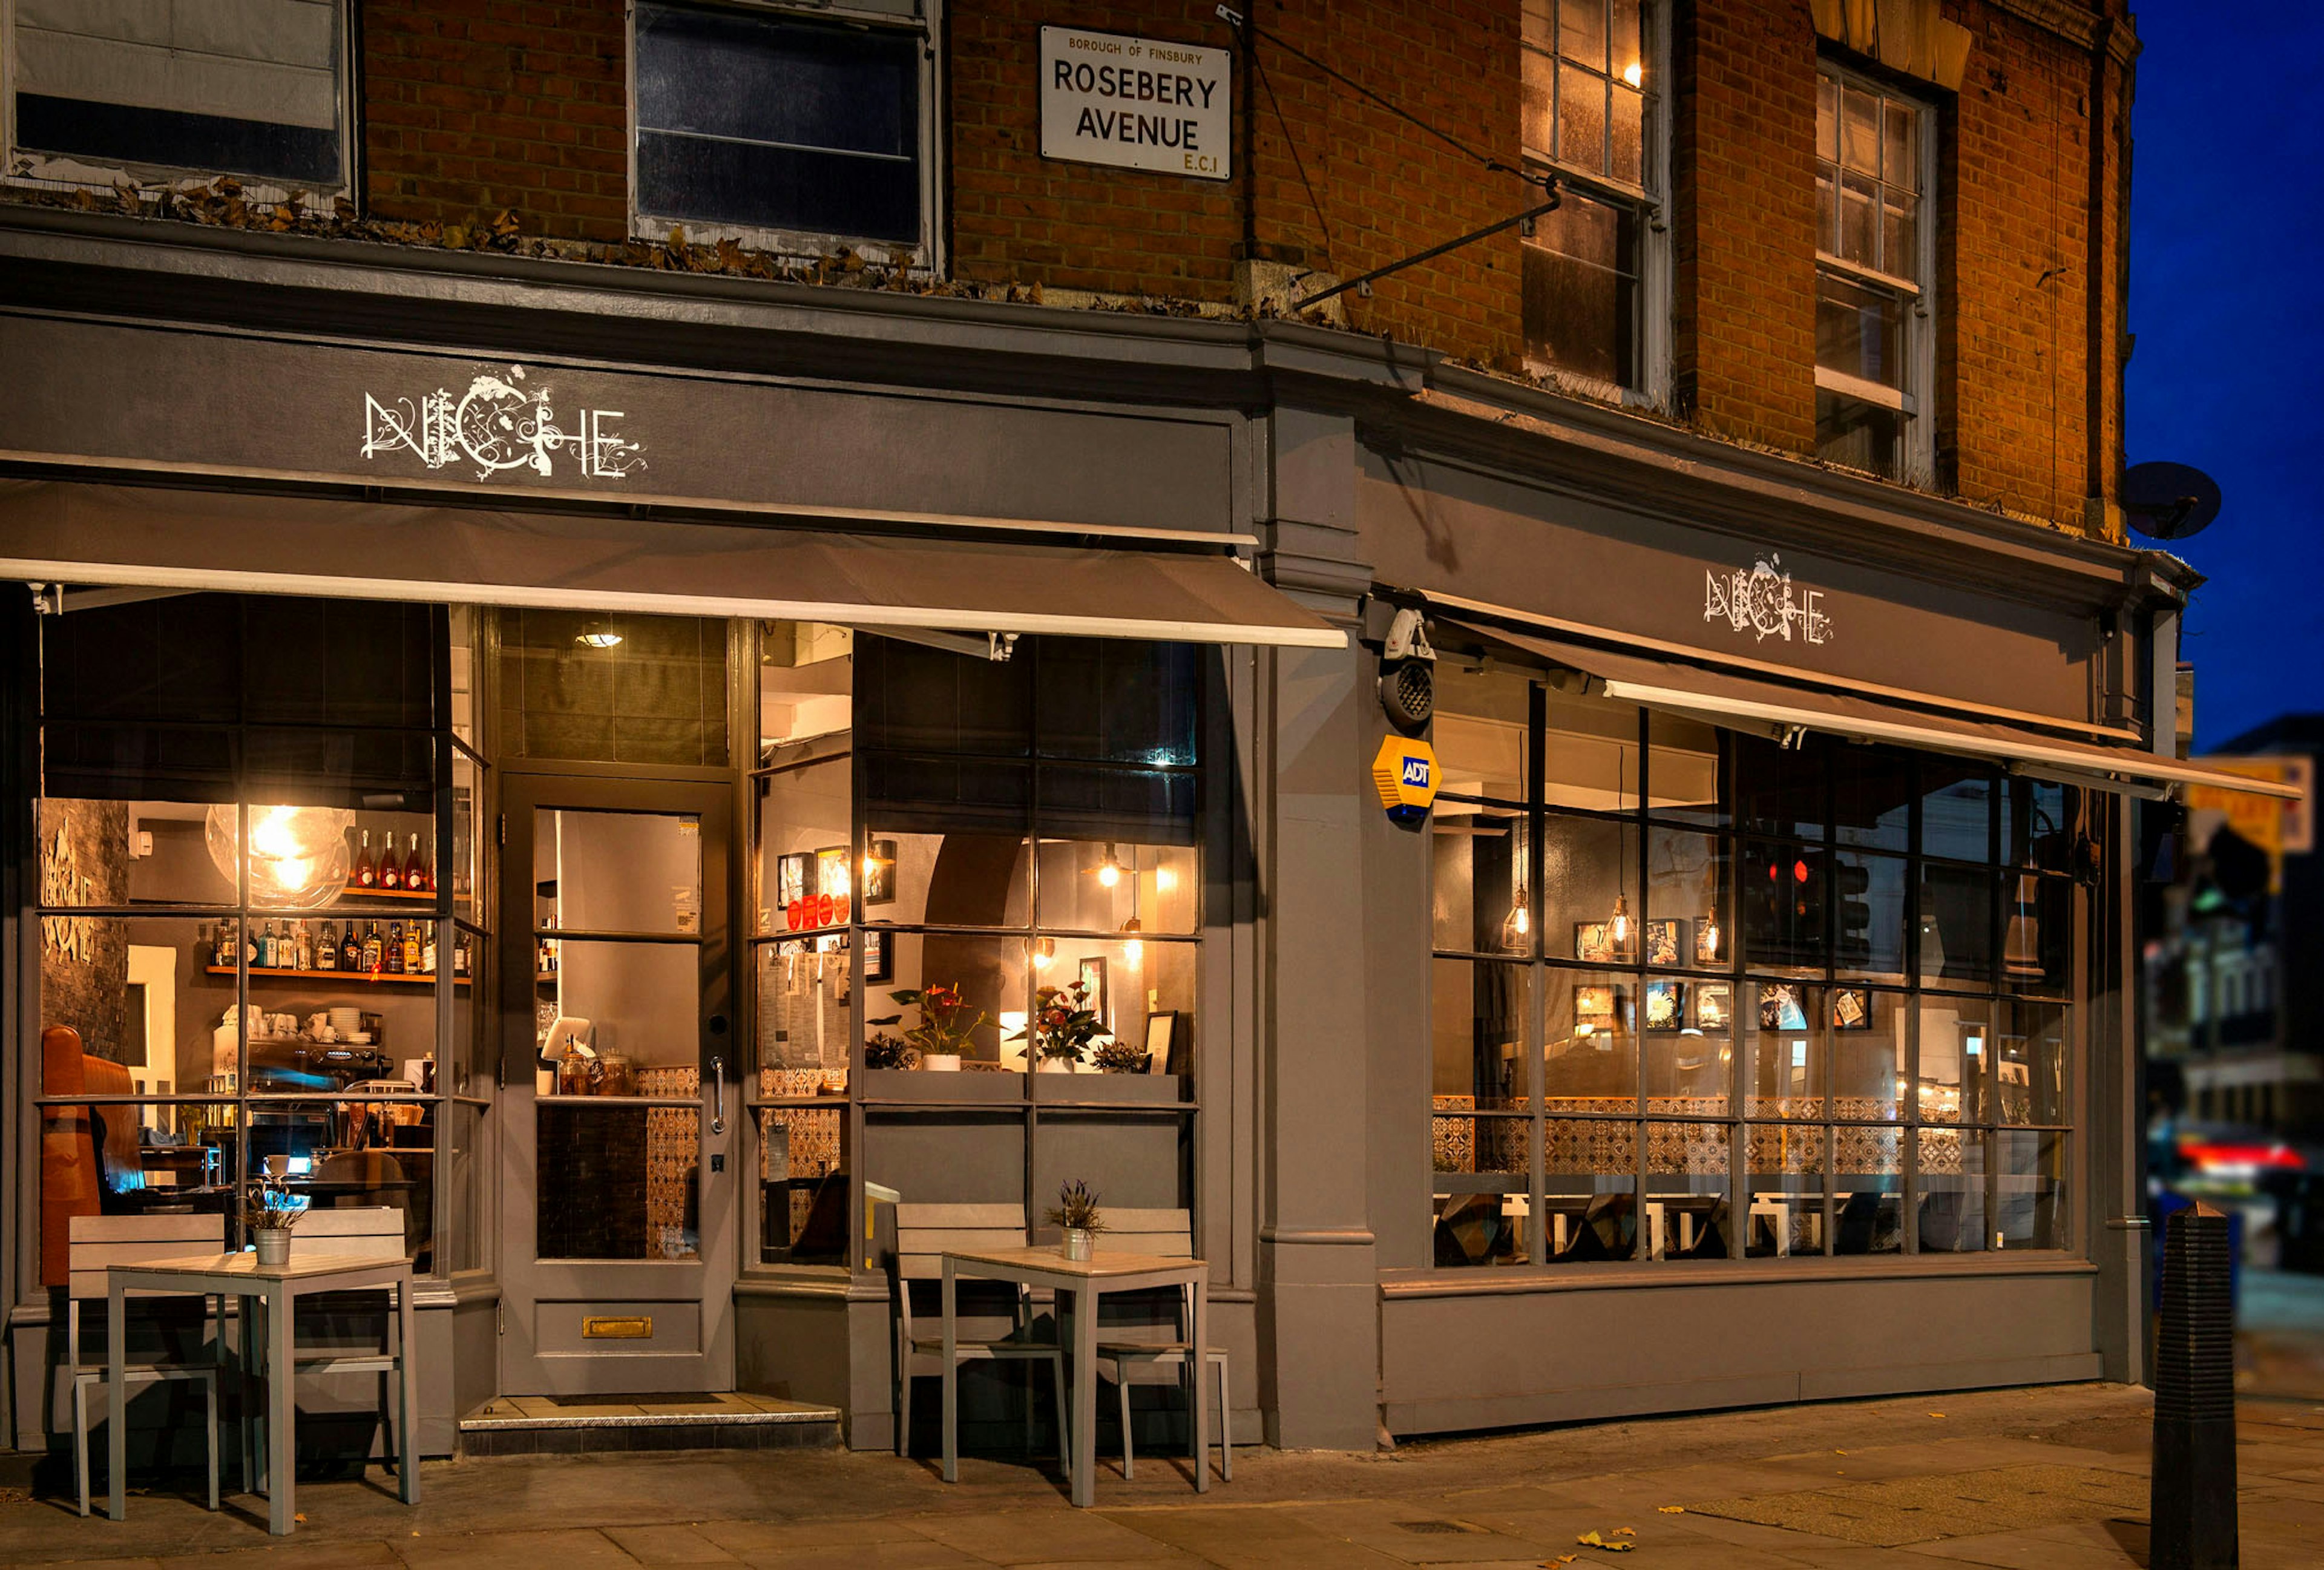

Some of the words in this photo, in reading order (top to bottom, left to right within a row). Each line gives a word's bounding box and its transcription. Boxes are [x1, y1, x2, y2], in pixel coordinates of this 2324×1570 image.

[1069, 38, 1121, 54] BOROUGH
[1129, 46, 1143, 57] OF
[1150, 48, 1203, 65] FINSBURY
[1055, 59, 1217, 110] ROSEBERY
[1076, 107, 1198, 151] AVENUE
[361, 364, 649, 482] NICHE
[1704, 553, 1834, 645] NICHE
[1403, 761, 1430, 784] ADT
